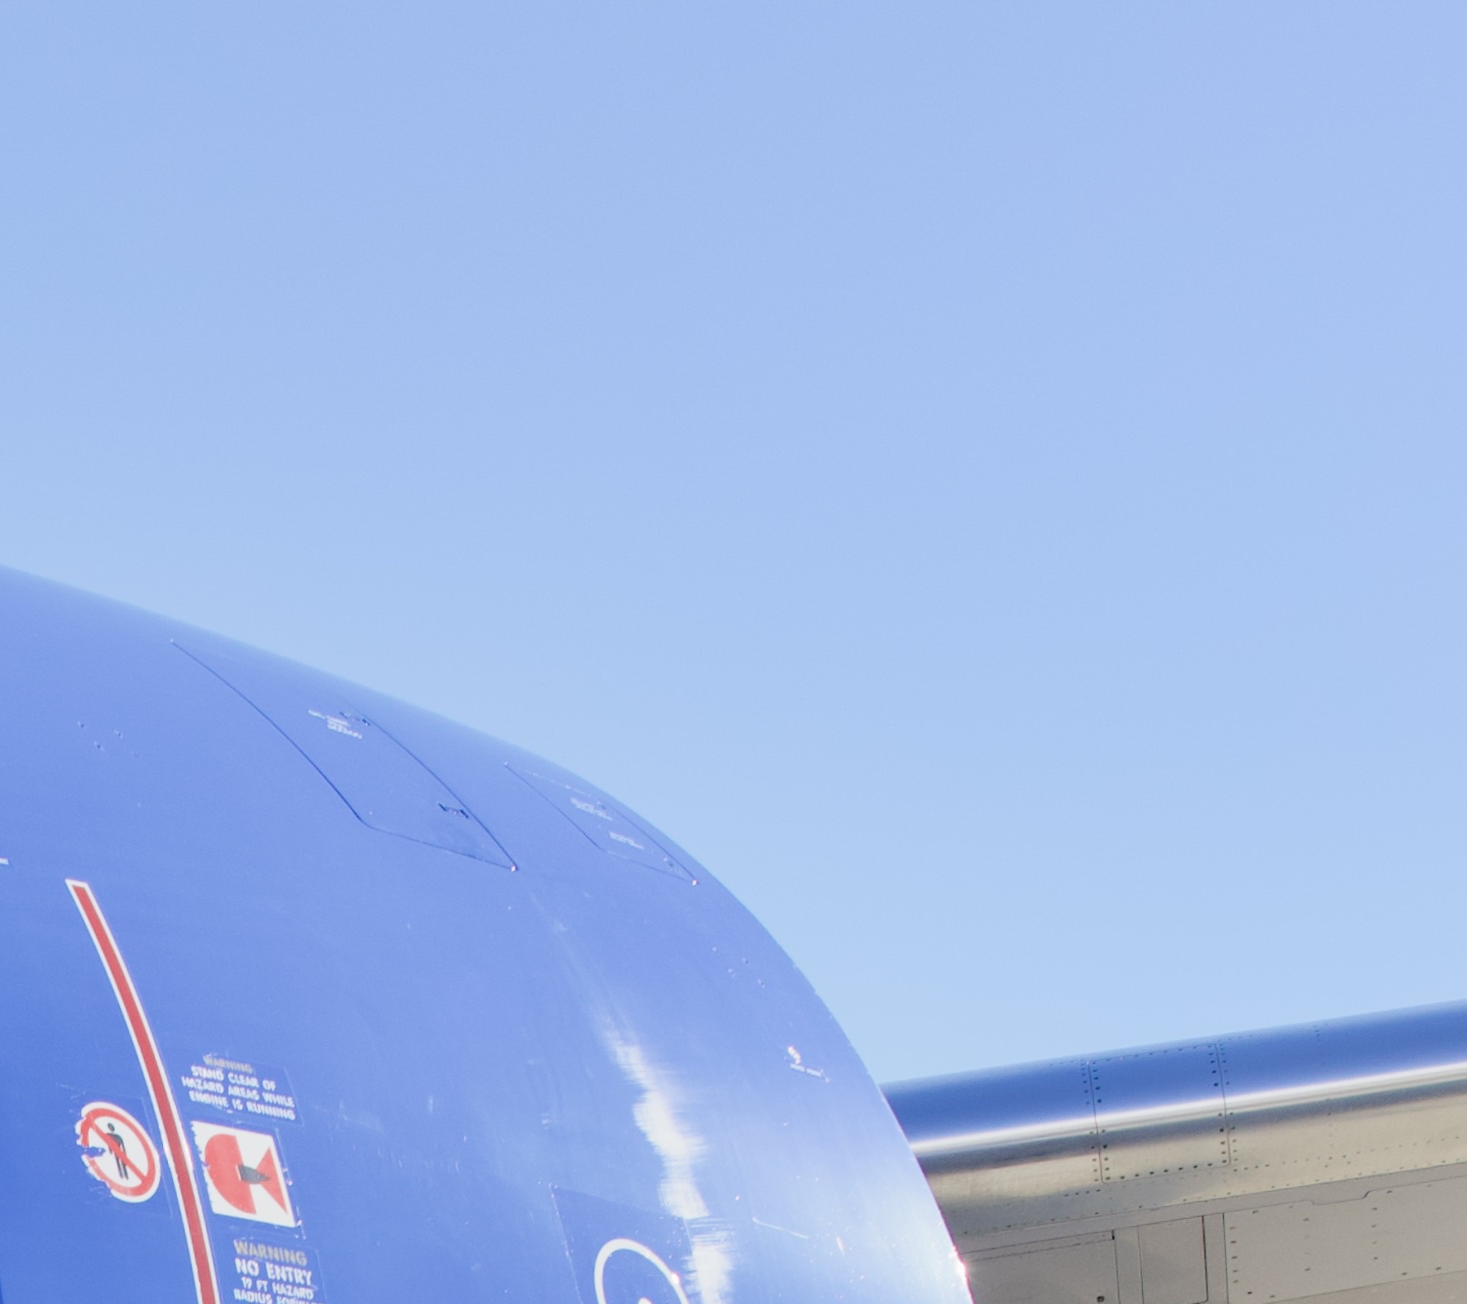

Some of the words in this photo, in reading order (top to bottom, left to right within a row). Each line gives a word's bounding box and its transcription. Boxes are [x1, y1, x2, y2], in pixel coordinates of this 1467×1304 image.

[181, 1075, 224, 1094] HAZARD
[228, 1085, 260, 1100] AREAS
[262, 1092, 295, 1108] WHILE
[191, 1065, 224, 1081] STAND
[228, 1072, 260, 1088] CLEAR
[262, 1079, 276, 1091] OF
[189, 1090, 229, 1108] ENGINE
[232, 1098, 243, 1110] IS
[246, 1101, 296, 1120] RUNNING
[233, 1239, 307, 1267] WARNING
[235, 1258, 259, 1277] NO
[266, 1262, 312, 1287] ENTRY
[241, 1276, 252, 1289] 19
[256, 1279, 268, 1292] FT
[272, 1282, 314, 1300] HAZARD
